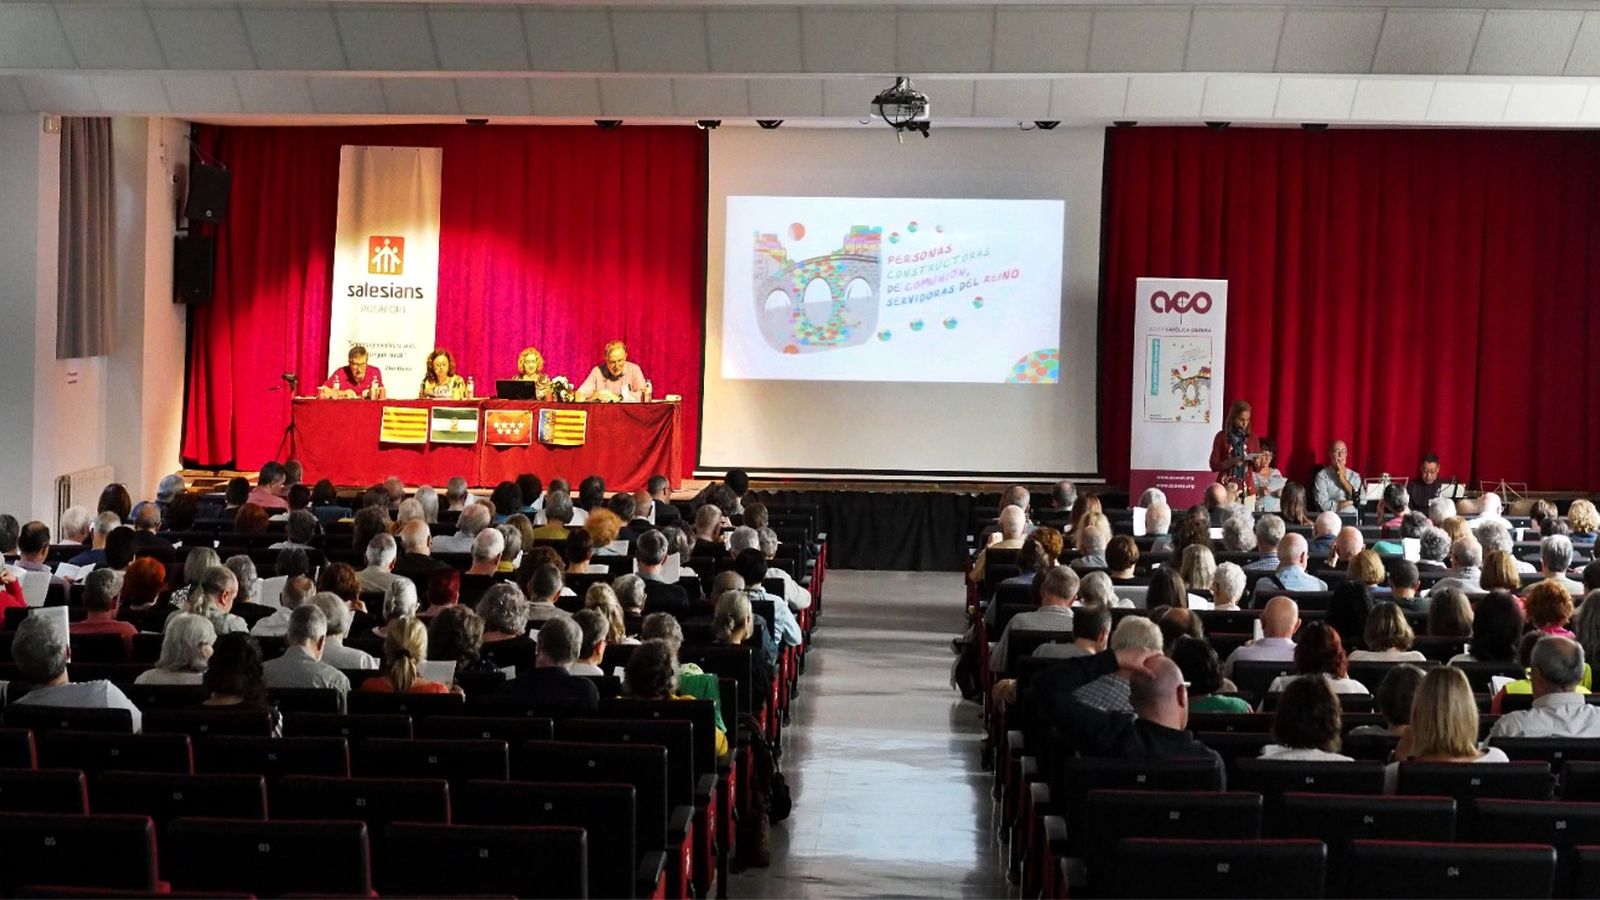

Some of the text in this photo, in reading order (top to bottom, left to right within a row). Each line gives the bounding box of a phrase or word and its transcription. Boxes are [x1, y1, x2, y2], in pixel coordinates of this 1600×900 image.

[887, 244, 952, 264] PERSONAS
[887, 248, 991, 279] CONSTRUCTORAS
[347, 282, 424, 299] salesians
[886, 269, 1020, 307] SERVIDORAS DEL REINO
[887, 284, 901, 293] DE
[360, 303, 407, 314] ROCAFORT
[45, 837, 56, 846] 05
[259, 843, 270, 852] 03
[1217, 863, 1229, 872] 02
[1448, 867, 1459, 876] 04
